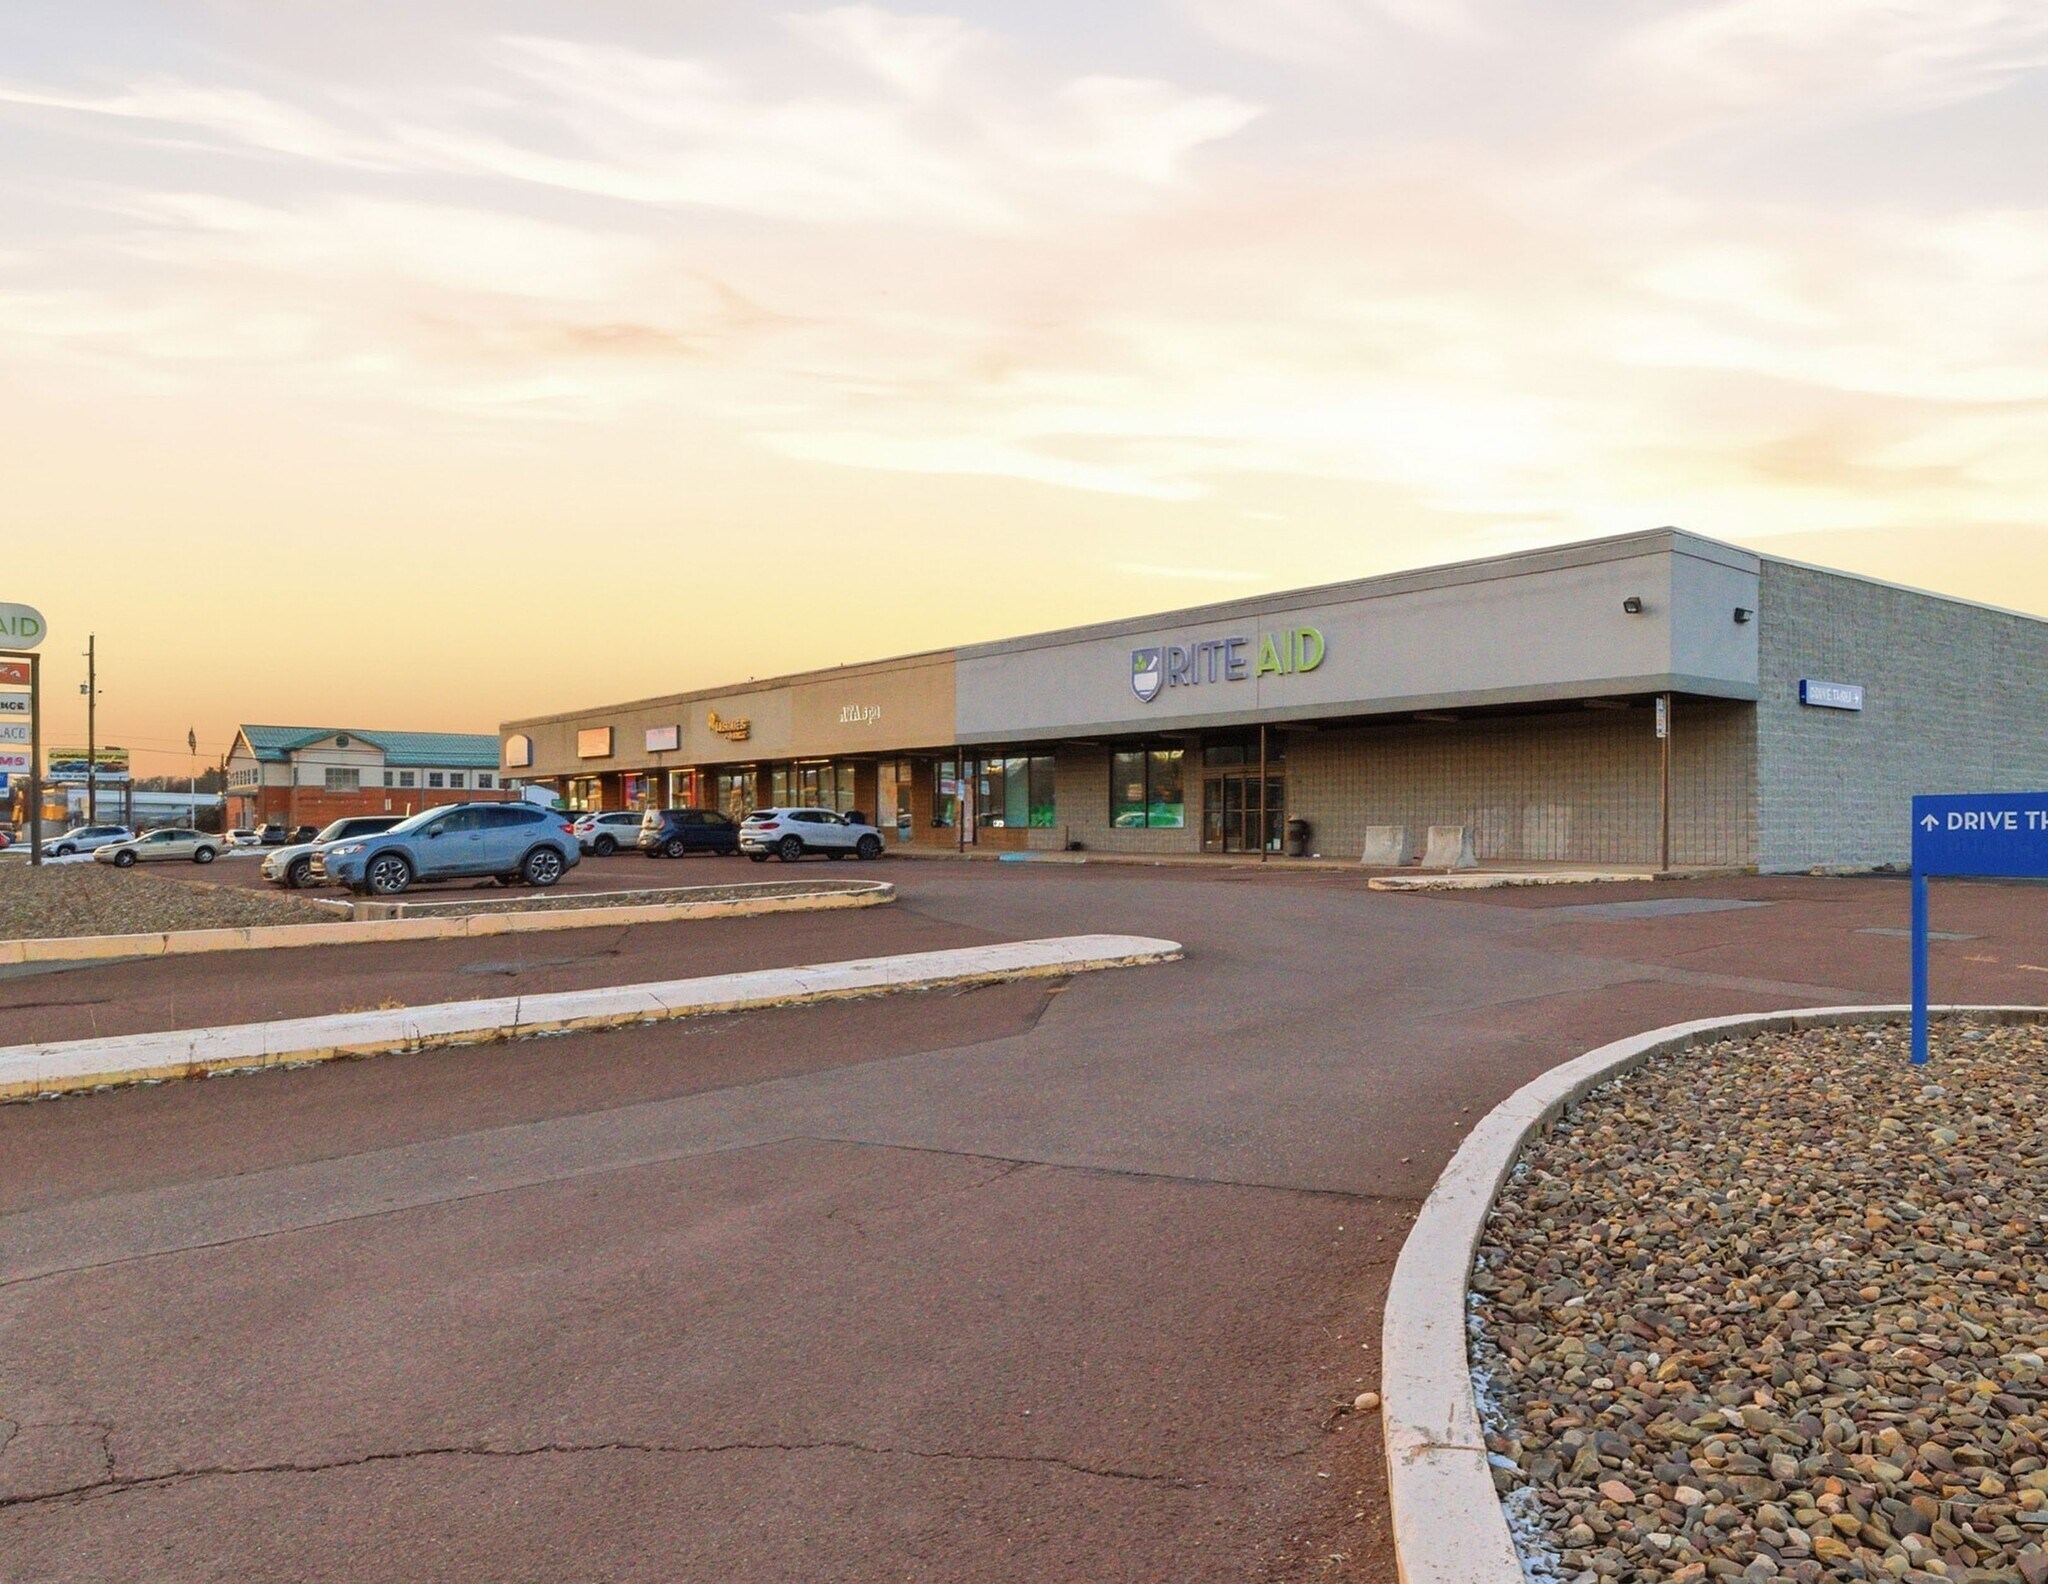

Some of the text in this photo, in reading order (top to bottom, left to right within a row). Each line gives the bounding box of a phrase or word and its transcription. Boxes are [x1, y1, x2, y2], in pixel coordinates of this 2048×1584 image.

[1166, 626, 1325, 687] RITE AID
[1947, 811, 2018, 831] DRIVE
